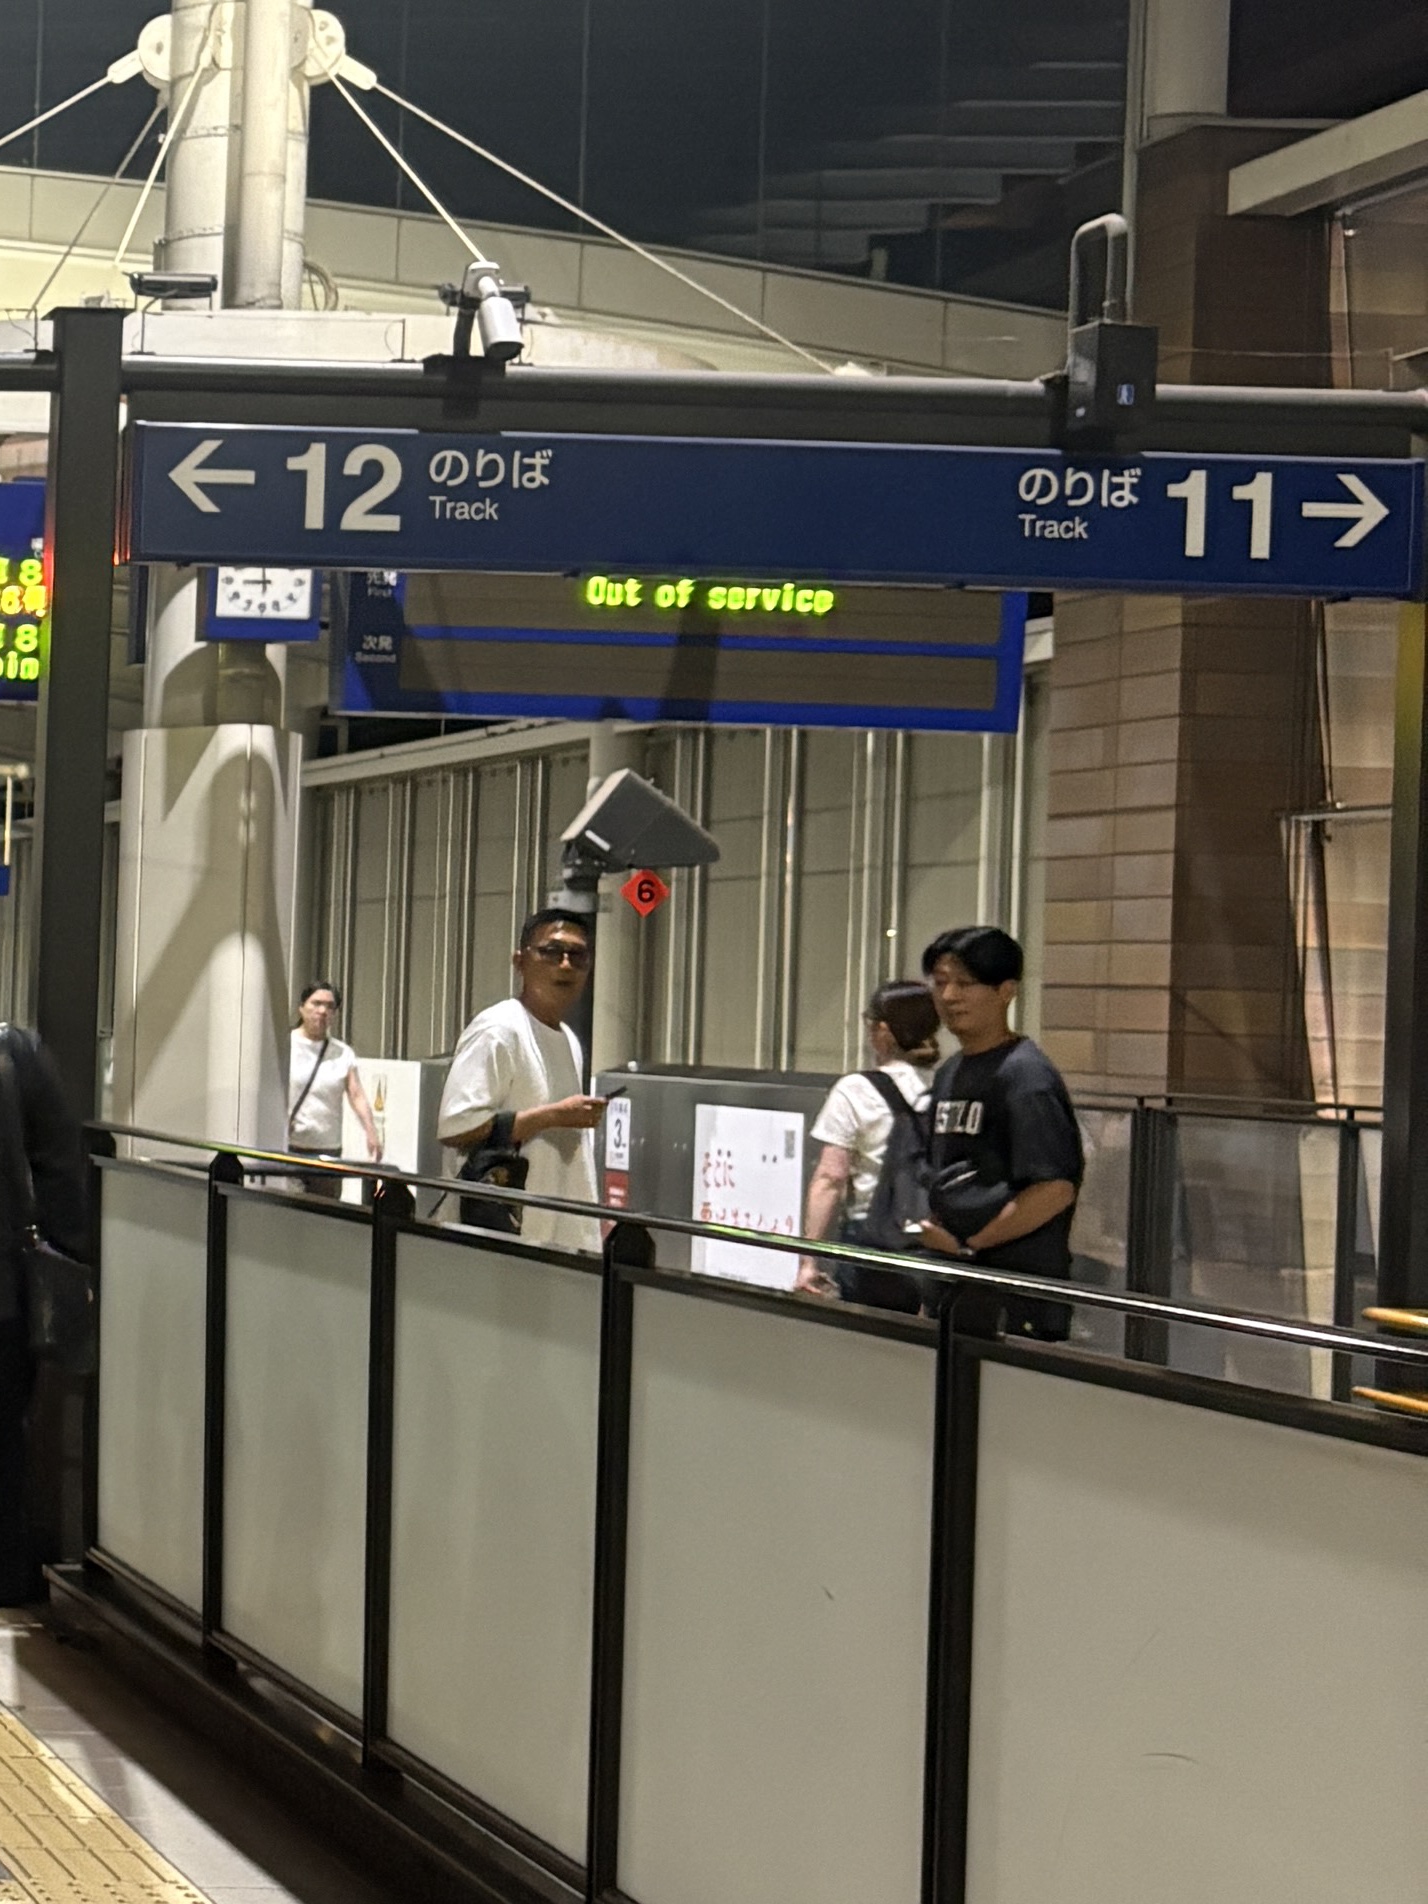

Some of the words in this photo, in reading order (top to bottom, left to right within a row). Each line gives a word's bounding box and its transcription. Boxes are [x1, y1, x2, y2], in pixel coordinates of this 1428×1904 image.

[286, 442, 402, 532] 12
[429, 448, 553, 488] のりば
[429, 496, 499, 520] Track
[1018, 466, 1142, 508] のりば
[1166, 469, 1273, 560] 11
[1018, 513, 1089, 539] Track
[587, 576, 642, 607] Out
[655, 579, 695, 608] of
[708, 583, 834, 614] service
[637, 879, 656, 903] 6
[613, 1118, 623, 1148] 3
